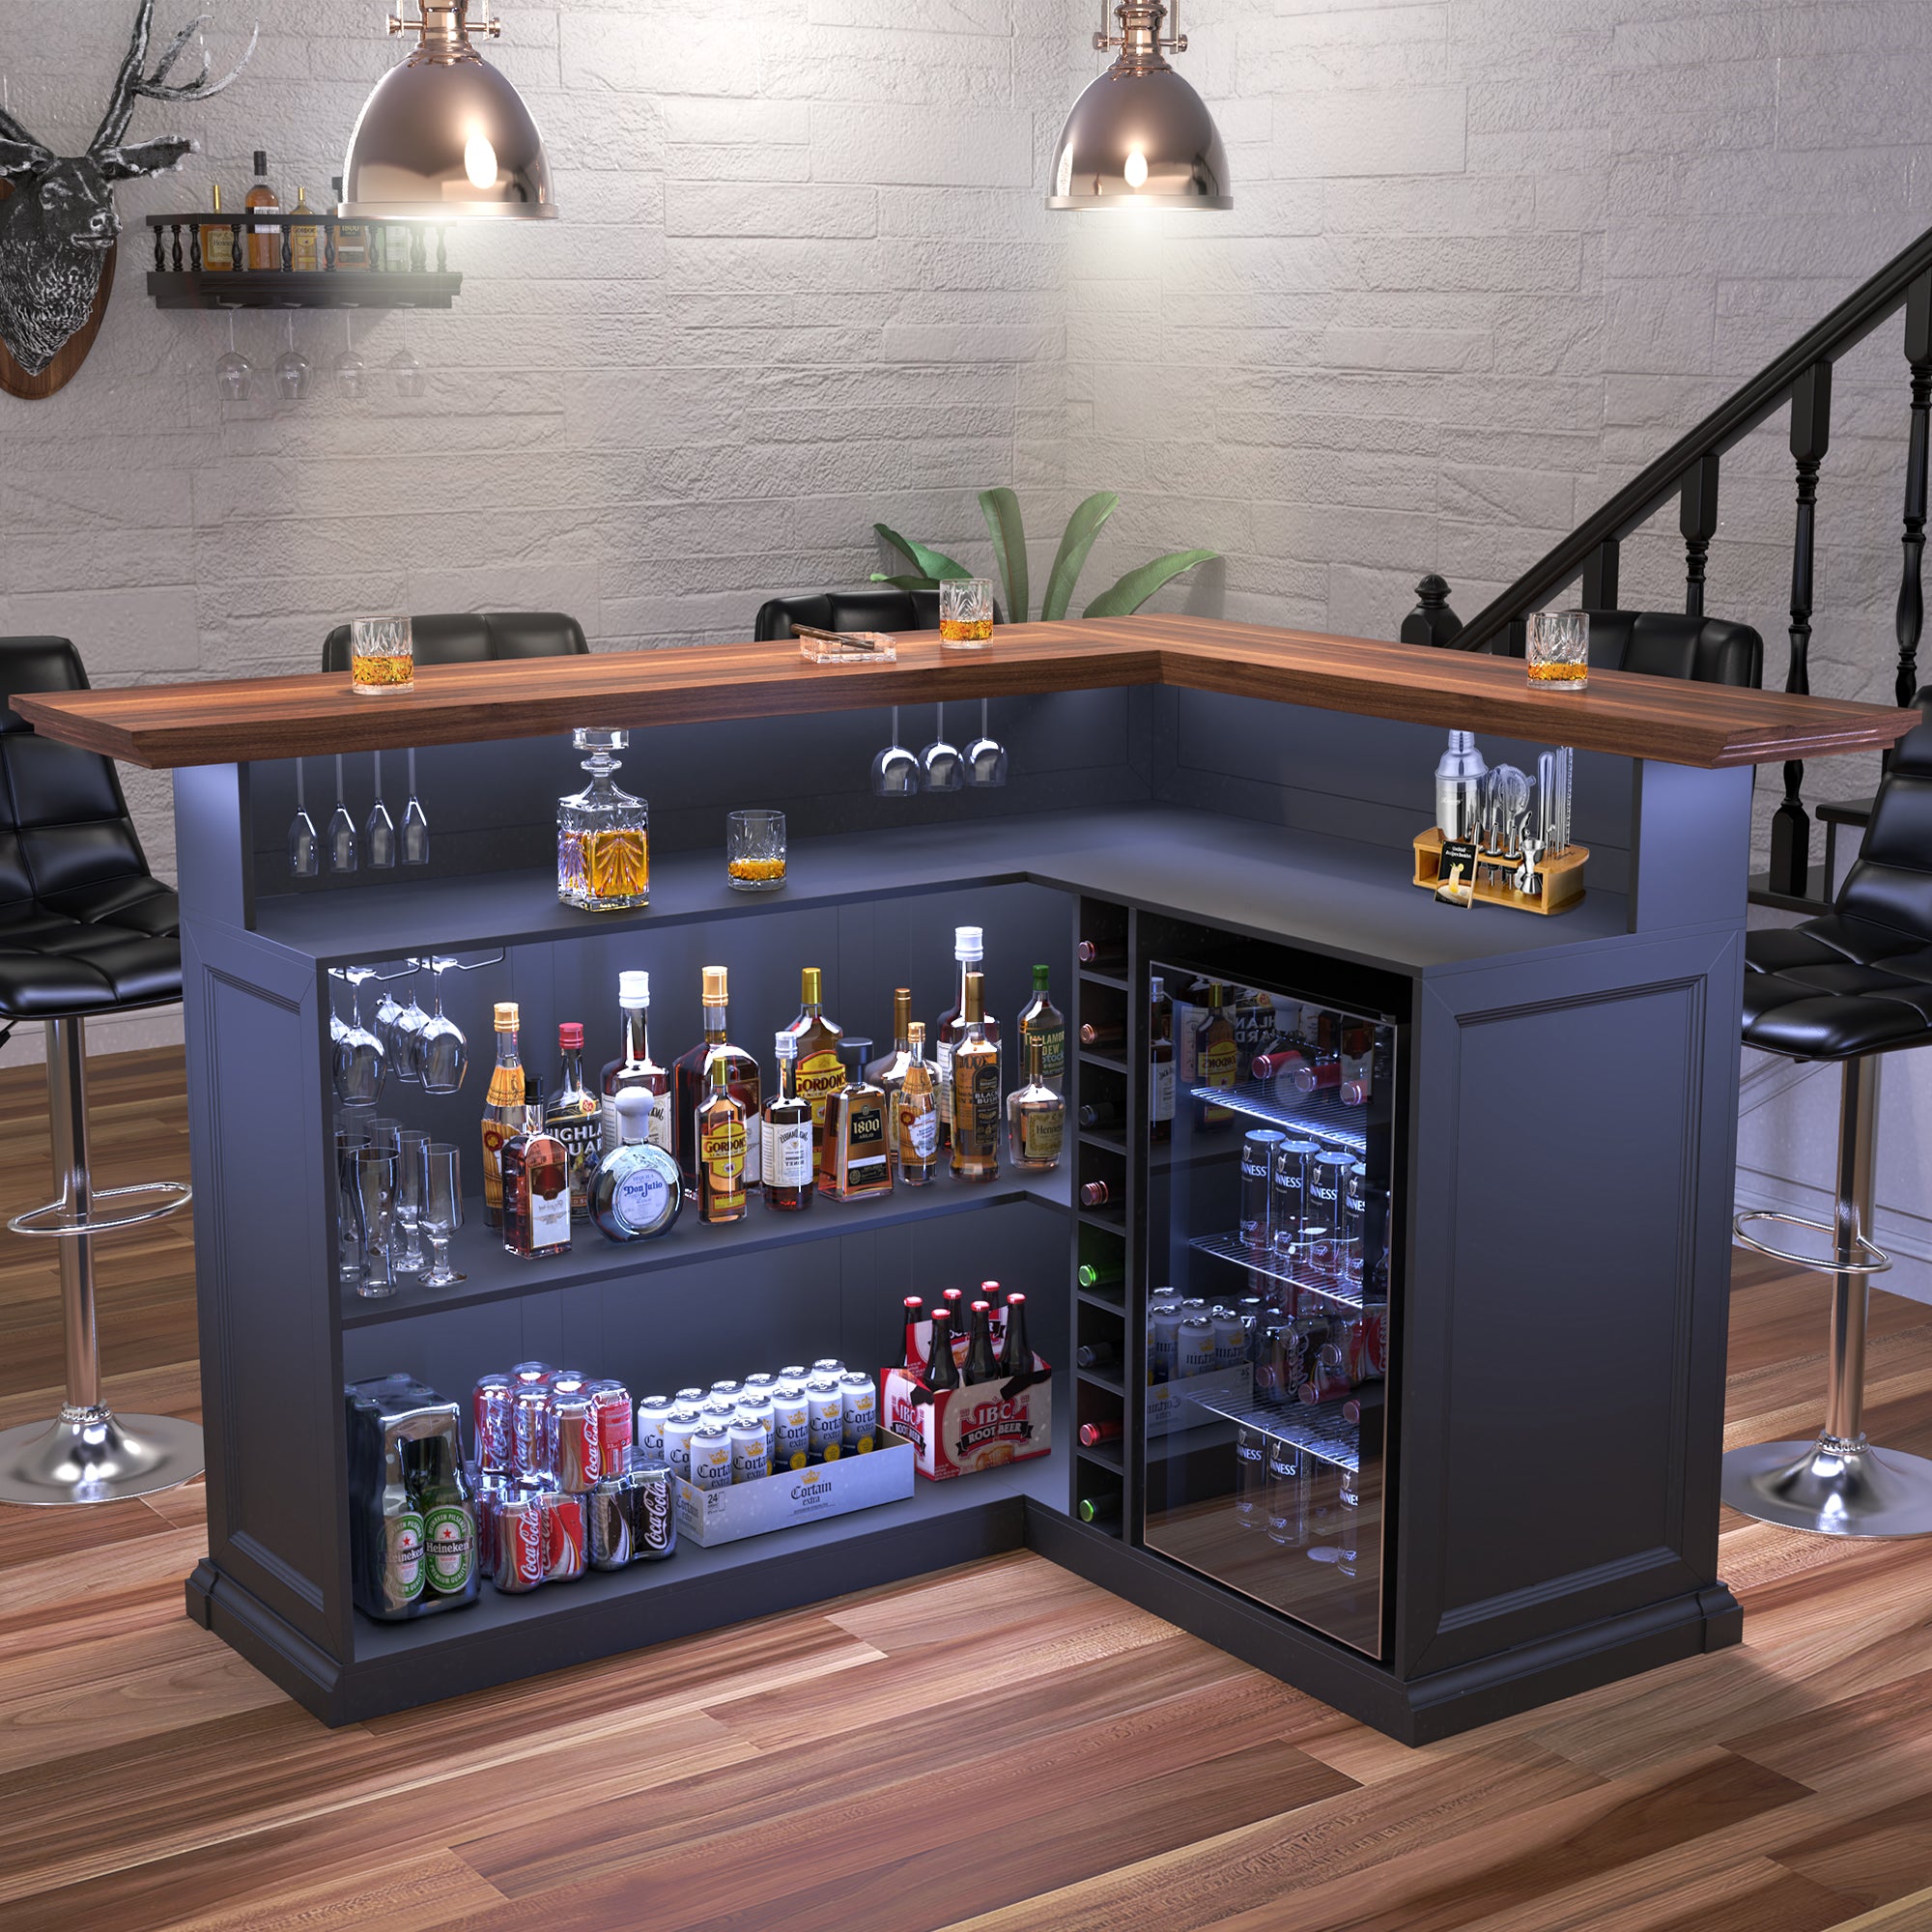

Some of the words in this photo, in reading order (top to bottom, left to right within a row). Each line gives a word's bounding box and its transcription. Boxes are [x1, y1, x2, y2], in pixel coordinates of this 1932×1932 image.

[1042, 1043, 1060, 1055] DEW
[546, 1122, 602, 1142] HIGHLA
[853, 1119, 880, 1134] 1800
[623, 1185, 643, 1196] Don
[641, 1181, 663, 1198] Julio
[844, 1409, 875, 1424] Corta
[979, 1404, 1012, 1425] IBC
[776, 1423, 809, 1439] Corta
[810, 1416, 842, 1432] Corta
[968, 1426, 997, 1443] ROOT
[998, 1422, 1022, 1435] BEER
[697, 1463, 731, 1479] Corta
[733, 1456, 766, 1470] Corta
[791, 1480, 832, 1500] Cortain
[708, 1493, 718, 1504] 24
[803, 1496, 820, 1506] extra
[426, 1541, 469, 1554] Heineken
